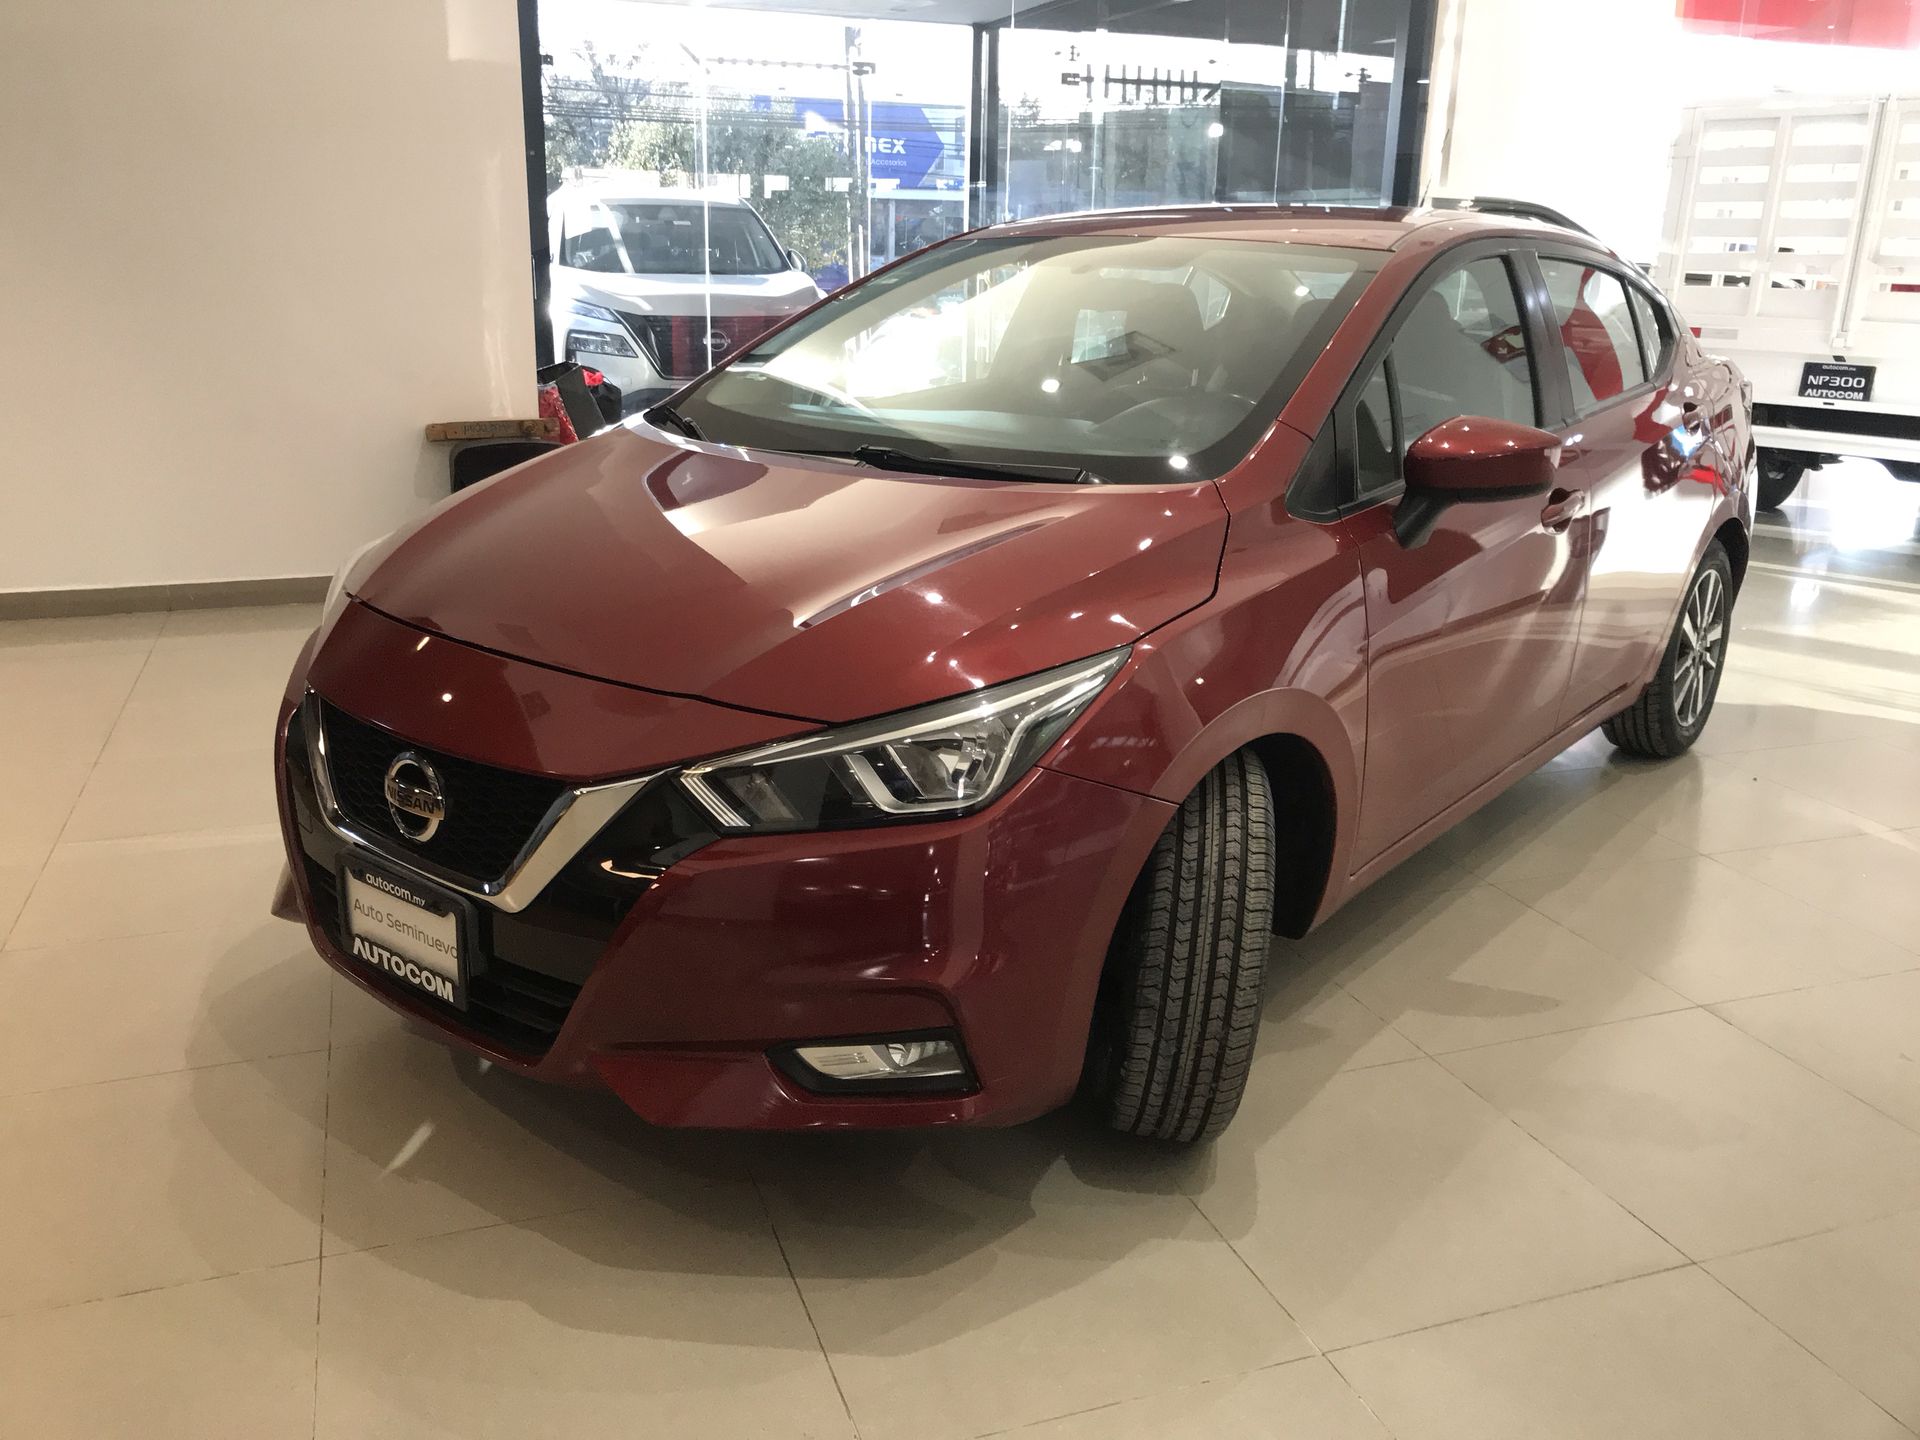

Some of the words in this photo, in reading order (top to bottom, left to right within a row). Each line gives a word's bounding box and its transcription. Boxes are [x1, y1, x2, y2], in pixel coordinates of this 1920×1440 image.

[1807, 375, 1866, 388] NP300
[1804, 388, 1864, 400] AUTOCOM
[353, 898, 384, 924] Auto
[353, 937, 454, 1002] AUTOCOM
